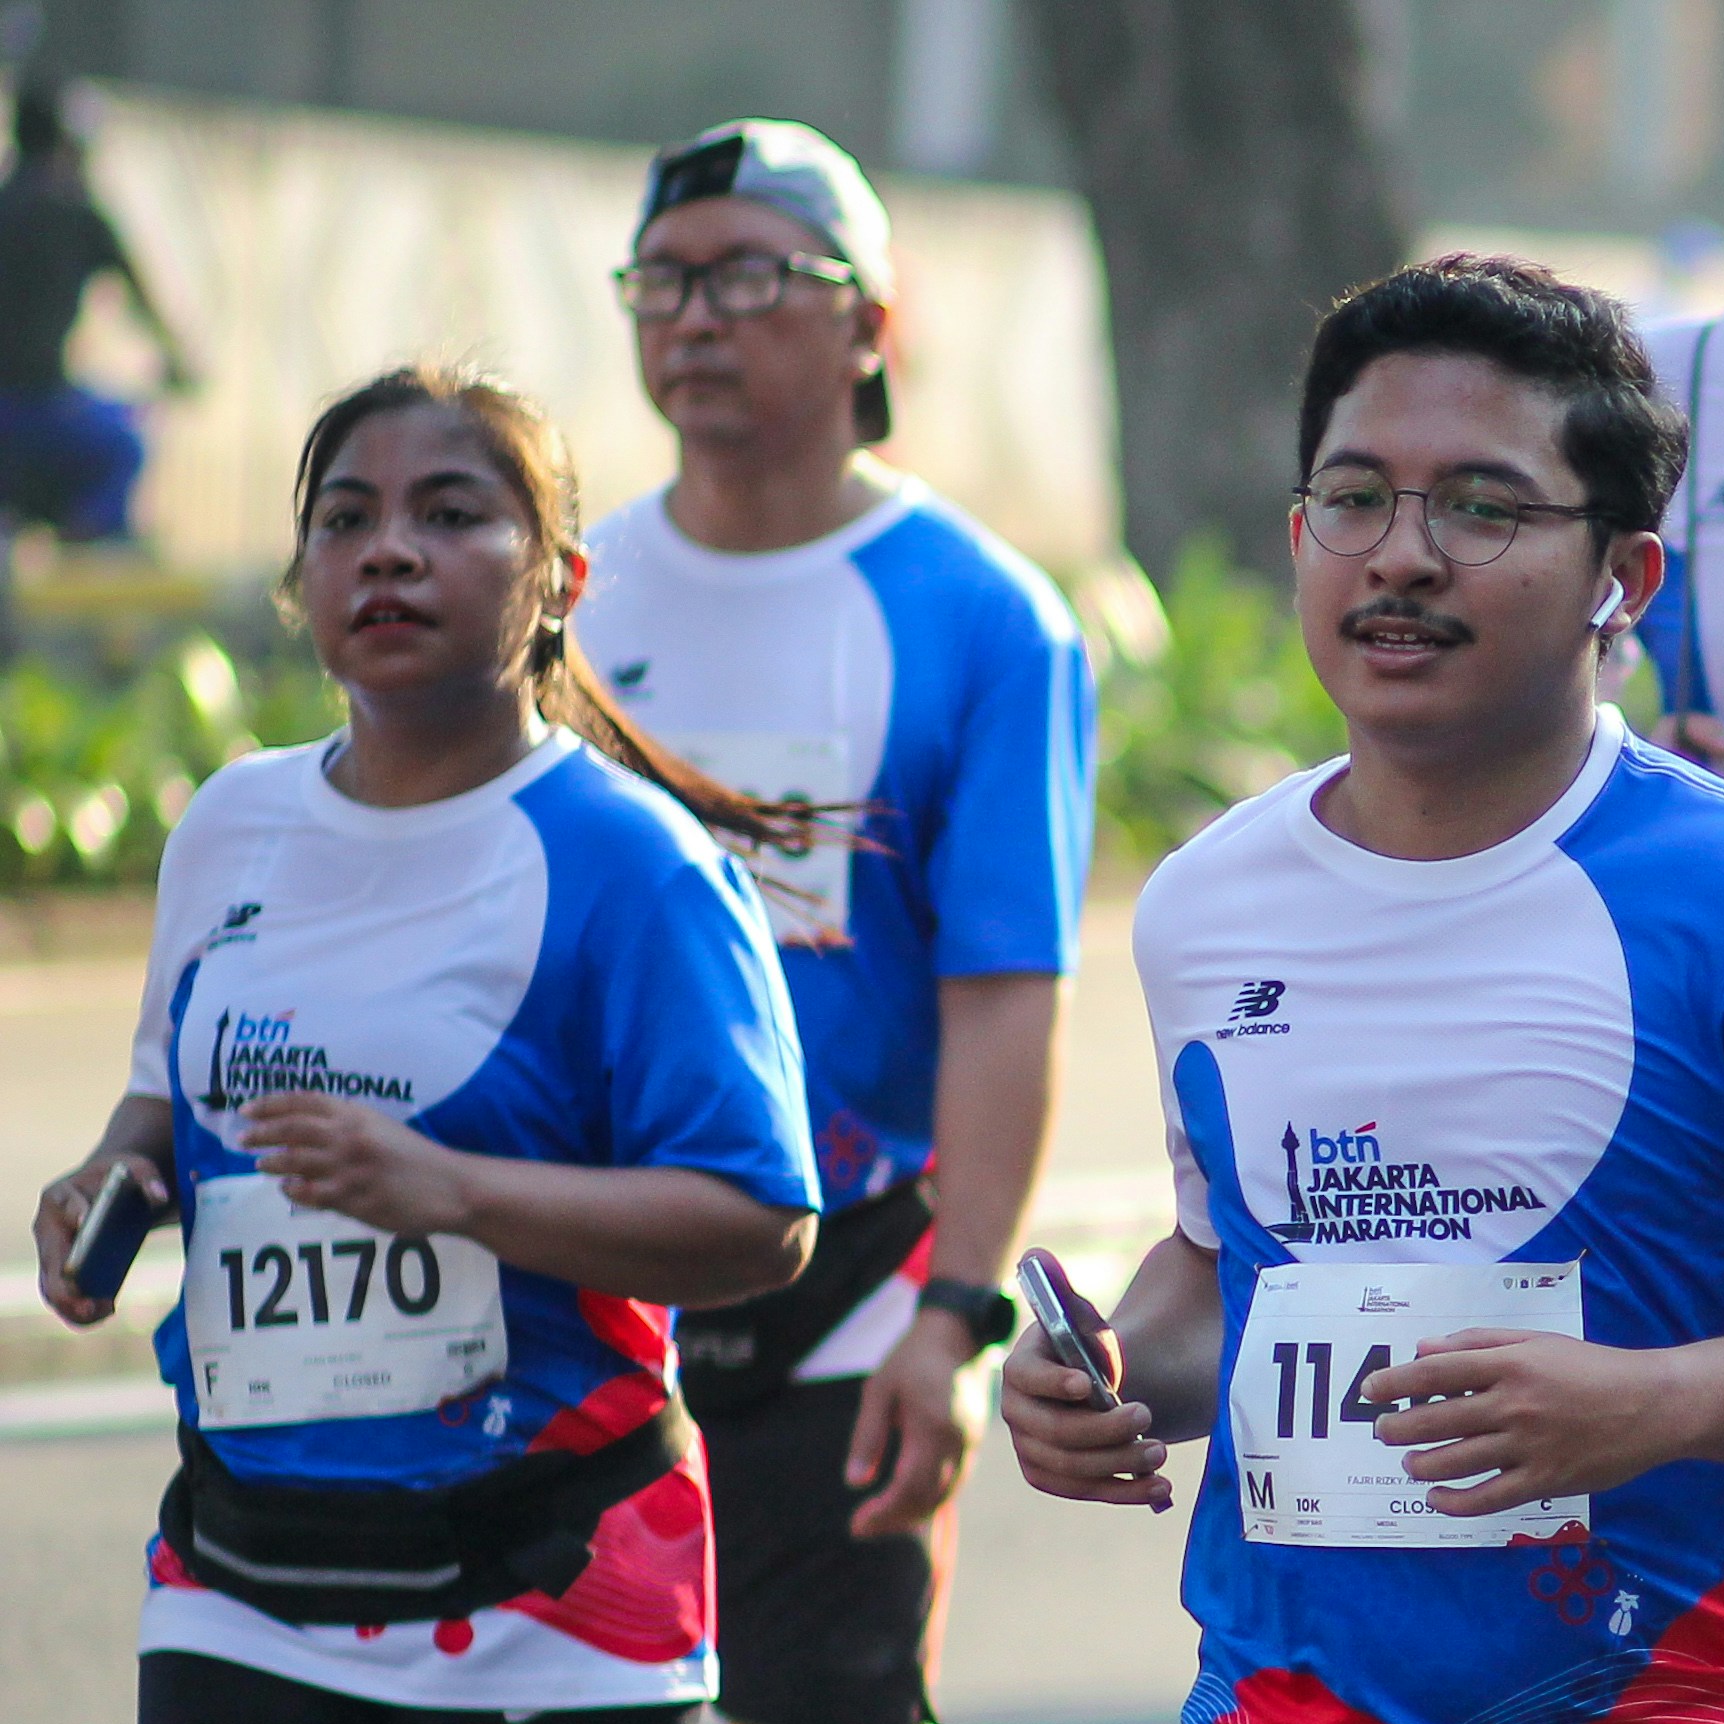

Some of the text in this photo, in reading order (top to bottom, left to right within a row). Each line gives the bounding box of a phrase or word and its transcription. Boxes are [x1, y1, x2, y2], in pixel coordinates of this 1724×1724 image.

[1237, 1022, 1290, 1036] balance
[228, 1044, 328, 1069] JAKARTA
[227, 1067, 415, 1103] INTERNATIONAL
[1306, 1164, 1441, 1193] JAKARTA
[1308, 1186, 1547, 1220] INTERNATIONAL
[1315, 1217, 1472, 1245] MARATHON
[219, 1233, 441, 1333] 12170
[205, 1362, 219, 1397] F
[1246, 1471, 1276, 1510] M
[1375, 1476, 1403, 1485] RIZKY
[1296, 1498, 1321, 1513] 10K
[1390, 1500, 1441, 1515] CLOS
